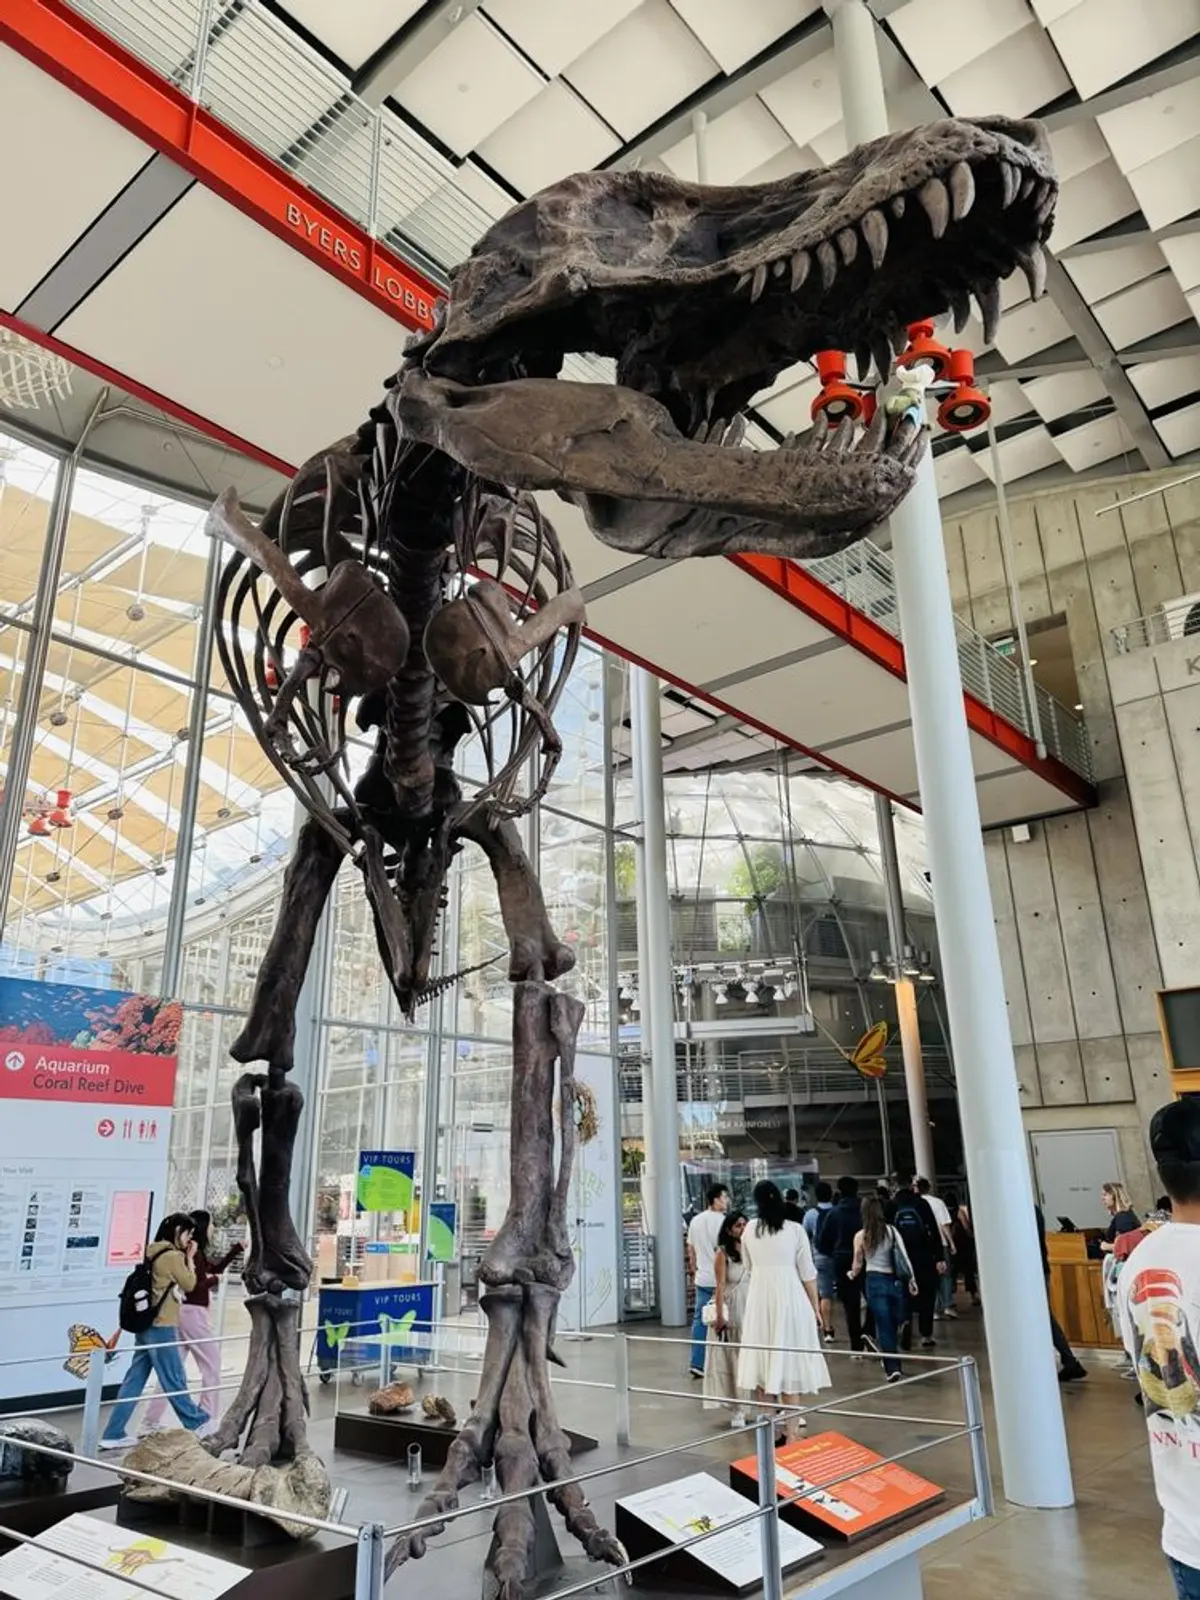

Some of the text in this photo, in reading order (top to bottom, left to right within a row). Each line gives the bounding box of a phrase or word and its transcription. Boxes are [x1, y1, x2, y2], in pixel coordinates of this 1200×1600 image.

[286, 203, 431, 320] BYERS LOBB
[35, 1056, 110, 1075] Aquarium
[33, 1073, 145, 1094] Coral Reef Dive
[363, 1155, 411, 1165] VIP TOURS
[374, 1292, 421, 1305] VIP TOURS
